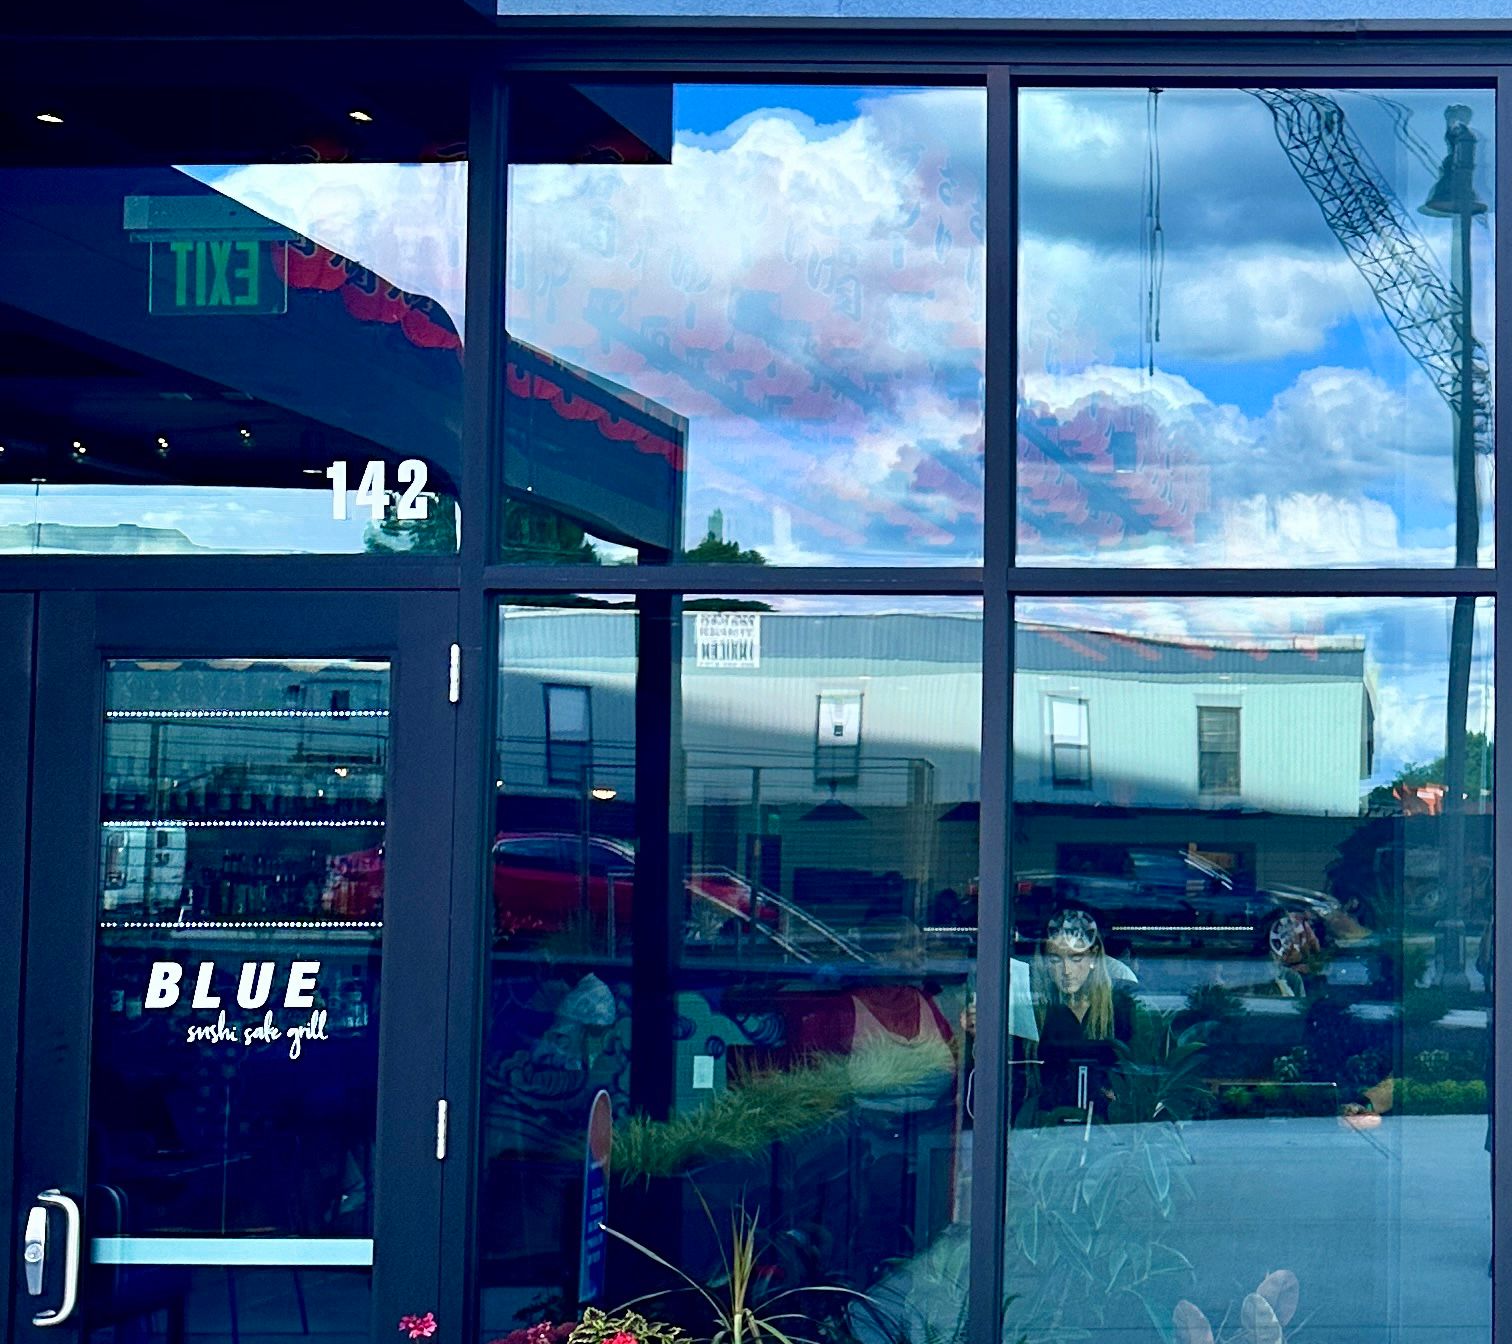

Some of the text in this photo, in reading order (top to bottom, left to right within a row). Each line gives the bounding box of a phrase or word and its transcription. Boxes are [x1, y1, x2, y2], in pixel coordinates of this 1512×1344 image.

[326, 459, 428, 520] 142
[145, 962, 321, 1009] BLUE
[187, 1010, 329, 1060] sushi sake grill
